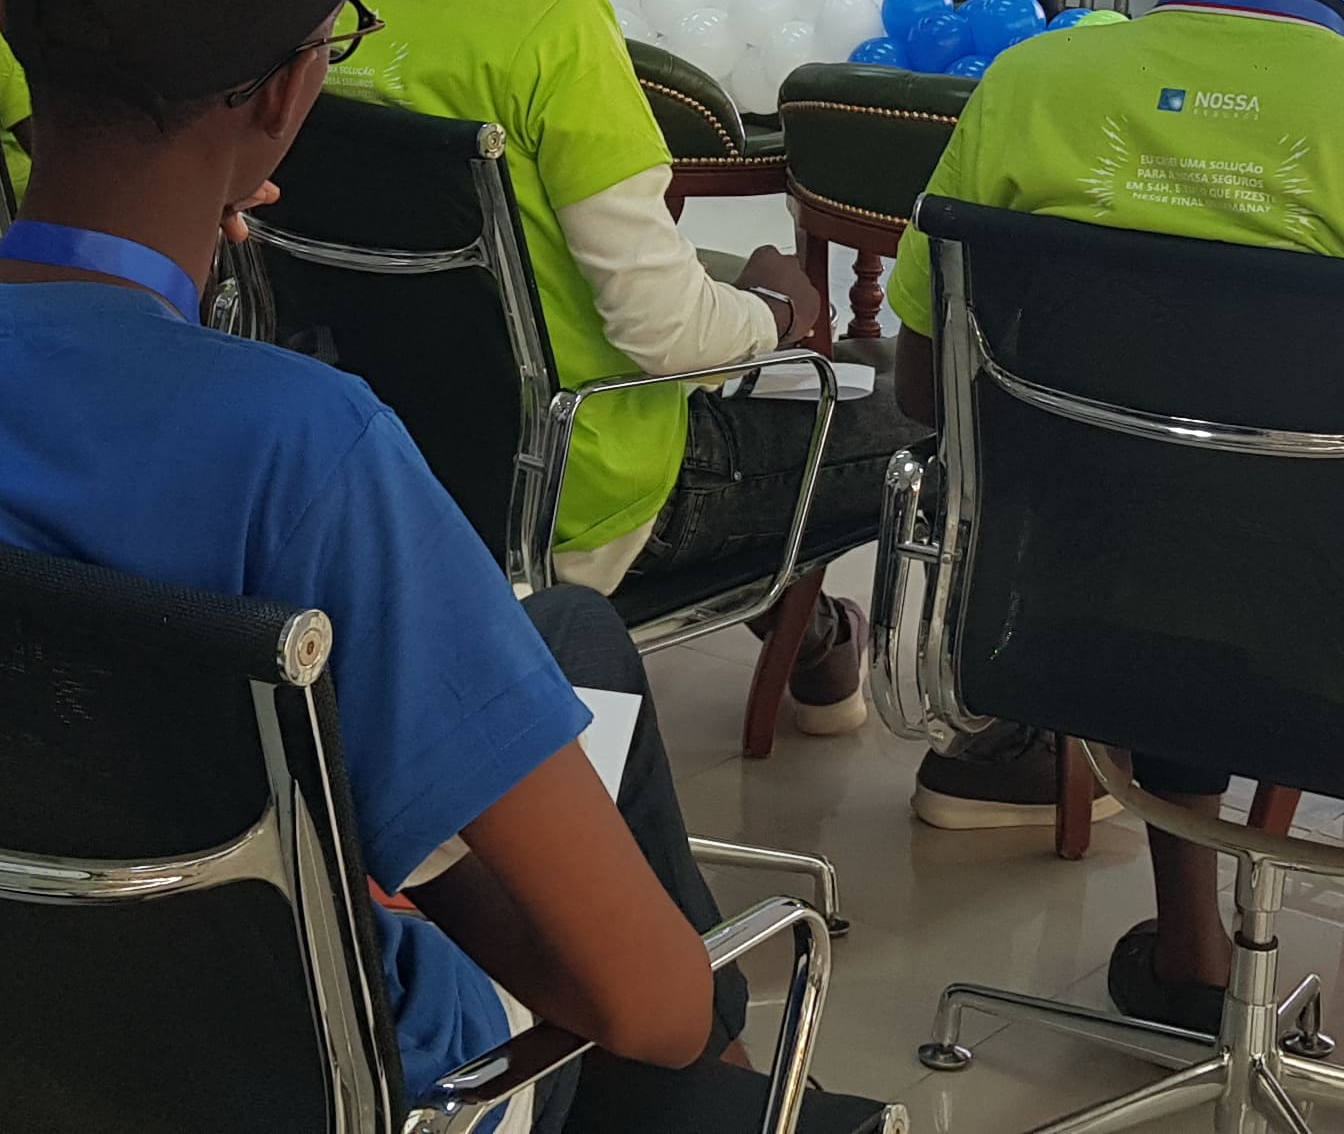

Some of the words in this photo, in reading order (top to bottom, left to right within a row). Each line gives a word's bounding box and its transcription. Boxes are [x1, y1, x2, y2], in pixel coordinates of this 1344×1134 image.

[1194, 90, 1261, 113] NOSSA
[1179, 157, 1206, 169] UMA
[1208, 161, 1264, 175] SOLUÇÃO
[1137, 168, 1167, 179] PARA
[1211, 174, 1264, 189] SEGUROS
[1126, 181, 1144, 191] EM
[1208, 187, 1232, 200] QUE
[1170, 196, 1205, 208] FINAL
